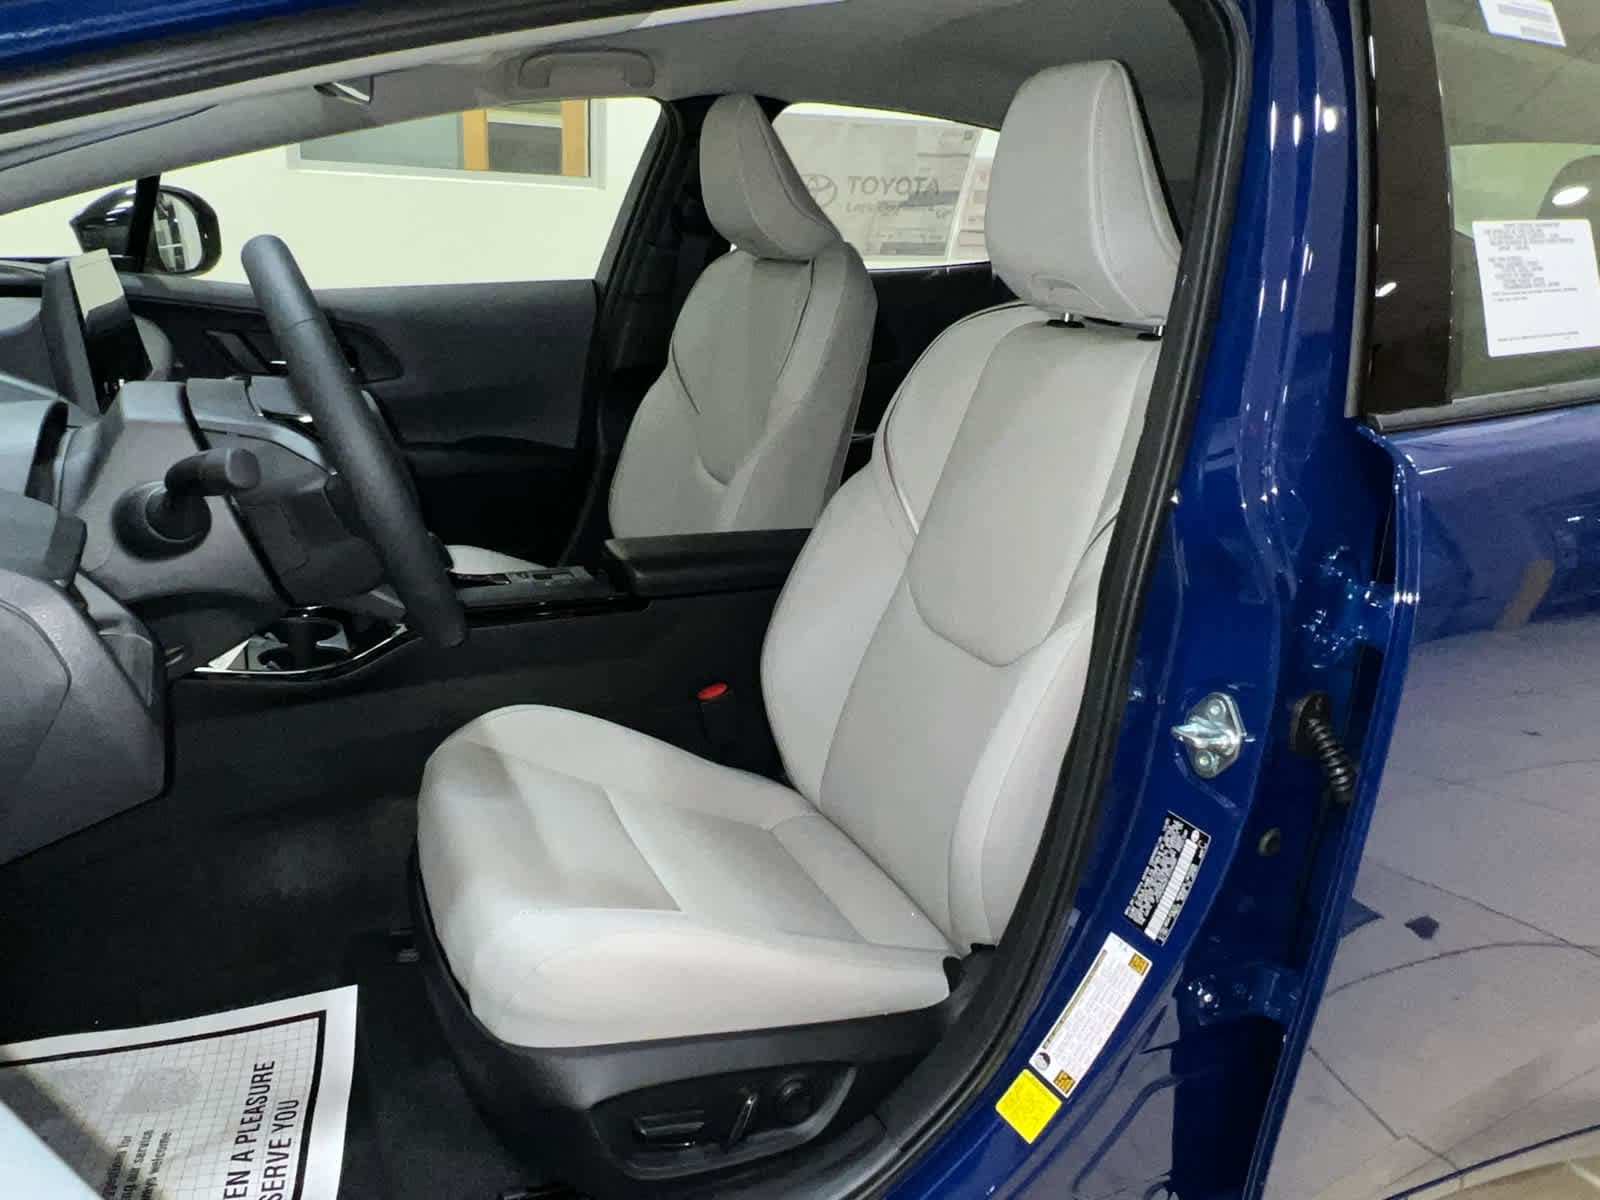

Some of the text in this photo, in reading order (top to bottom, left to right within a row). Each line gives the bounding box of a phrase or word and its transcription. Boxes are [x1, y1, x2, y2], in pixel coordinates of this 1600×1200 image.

[847, 176, 940, 195] TOYOTA
[234, 1060, 276, 1145] PLEASURE
[230, 1149, 256, 1162] A
[259, 1099, 300, 1200] SERVE YOU
